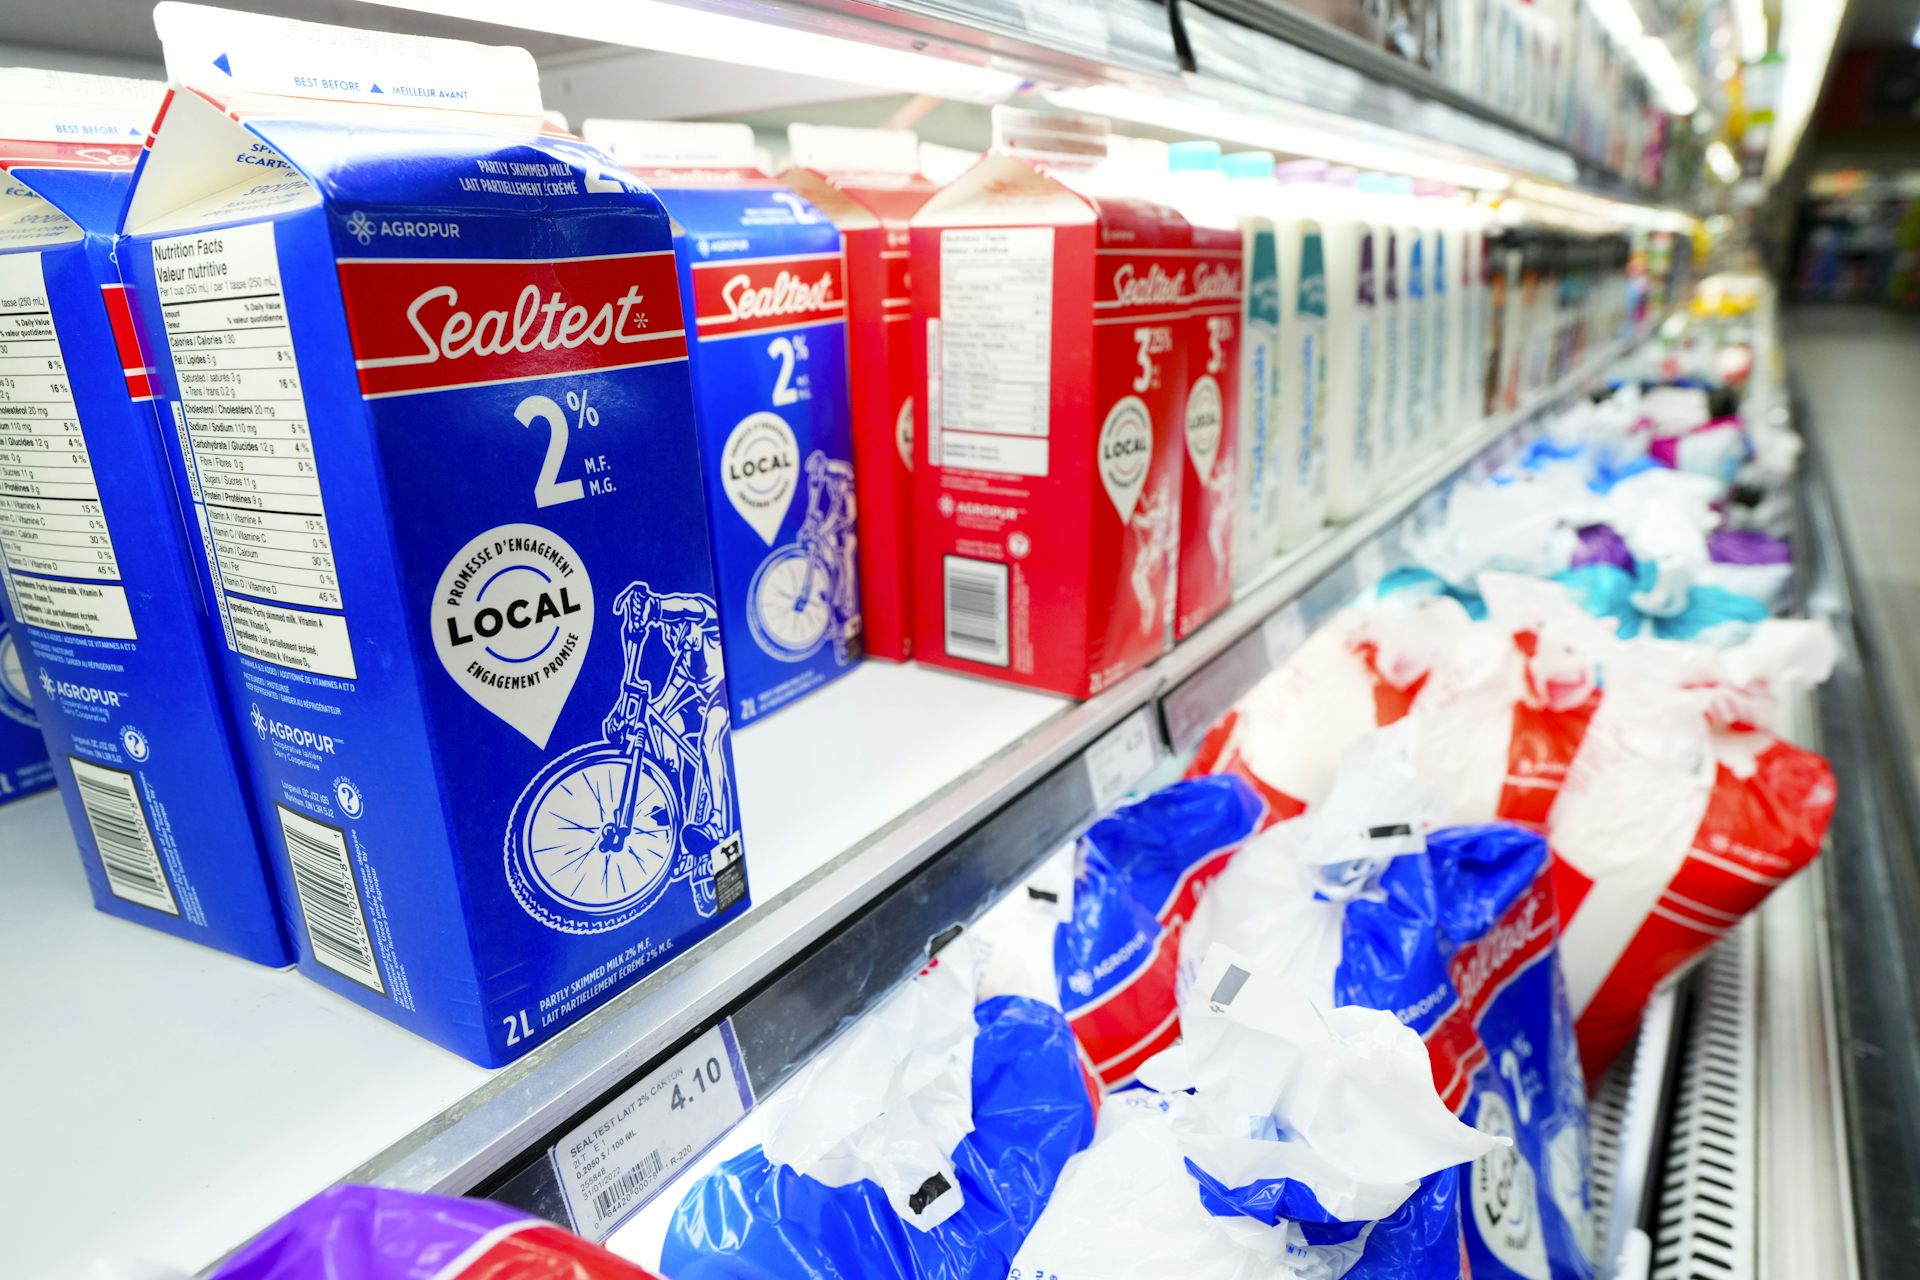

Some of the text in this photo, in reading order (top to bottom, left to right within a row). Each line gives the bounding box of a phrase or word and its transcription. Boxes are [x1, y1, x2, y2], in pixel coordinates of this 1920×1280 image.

[293, 76, 360, 92] BEST BEFORE
[391, 86, 469, 100] MEILLEUR AVANT
[55, 124, 119, 135] BEST BEFORE
[477, 160, 573, 177] PARTLY SKIMMED MILK
[459, 177, 480, 191] LAIT
[481, 179, 542, 196] PARTIELLEMENT
[381, 222, 460, 239] AGROPUR
[154, 238, 223, 261] Nutrition Facts
[157, 261, 227, 283] Valeur nutritive
[174, 287, 185, 297] cup
[214, 282, 223, 292] par
[231, 280, 246, 290] tasse
[18, 297, 45, 307] (250 mL)
[250, 302, 281, 312] Daily Value
[21, 319, 34, 327] Daily
[165, 310, 181, 319] Amount
[233, 314, 283, 325] valeur quotidienne
[166, 321, 180, 329] Teneur
[406, 284, 645, 364] Sealtest
[20, 329, 52, 338] quotidienne
[170, 334, 236, 348] Calories Calories 130
[174, 353, 206, 366] Fat Lipides
[182, 371, 230, 383] Saturated saturés
[50, 384, 59, 392] 16
[189, 386, 220, 396] Trans trans
[37, 407, 48, 417] mg
[185, 403, 275, 417] Cholesterol Cholestérol 20 mg
[188, 421, 257, 435] Sodium Sodium 110 mg
[8, 437, 34, 446] Glucides
[192, 438, 269, 452] Carbohydrate Glucides 12
[1104, 440, 1147, 460] LOCAL
[200, 456, 232, 468] Fibre Fibres
[584, 455, 611, 474] M.F.
[730, 453, 792, 480] LOCAL
[204, 473, 242, 486] Sugars Sucres
[589, 477, 617, 497] M.G.
[204, 490, 251, 504] Protein Protéines
[82, 505, 91, 513] 15
[233, 512, 257, 525] Vitamine
[305, 521, 315, 530] 15
[90, 536, 99, 544] 30
[237, 529, 260, 542] Vitamine
[215, 542, 322, 566] Calcium Calcium 30
[98, 566, 106, 574] 45
[447, 538, 574, 606] PROMESSE D'ENGAGEMENT
[248, 579, 329, 602] Vitamine 45
[298, 614, 318, 626] Vitamin
[447, 587, 581, 647] LOCAL
[467, 632, 579, 690] ENGAGEMENT PROMISE
[312, 677, 338, 690] VITAMINES
[57, 681, 120, 707] AGROPUR
[269, 719, 336, 755] AGROPUR
[288, 754, 320, 772] Cooperative
[359, 867, 372, 898] Marque
[340, 863, 372, 963] 64420 00078
[539, 937, 652, 1012] PARTLY SKIMMED MILK 2% M.F.
[541, 939, 674, 1028] LAIT PARTIELLEMENT ÉCRÉMÉ 2% M.G.
[1397, 983, 1447, 1024] GROPUR
[503, 1008, 535, 1047] 2L
[670, 1056, 722, 1112] 4.10
[570, 1066, 684, 1158] SEALTEST LAIT 2% CARTON
[573, 1153, 586, 1169] 2LT
[594, 1143, 600, 1152] E
[576, 1157, 600, 1180] 0.2050
[600, 1152, 606, 1161] $
[611, 1137, 624, 1151] 100
[625, 1128, 638, 1140] ML
[670, 1143, 692, 1165] R-220
[580, 1167, 606, 1192] 255848
[583, 1166, 621, 1201] 31/01/2022
[594, 1171, 658, 1230] 0 64420 00078
